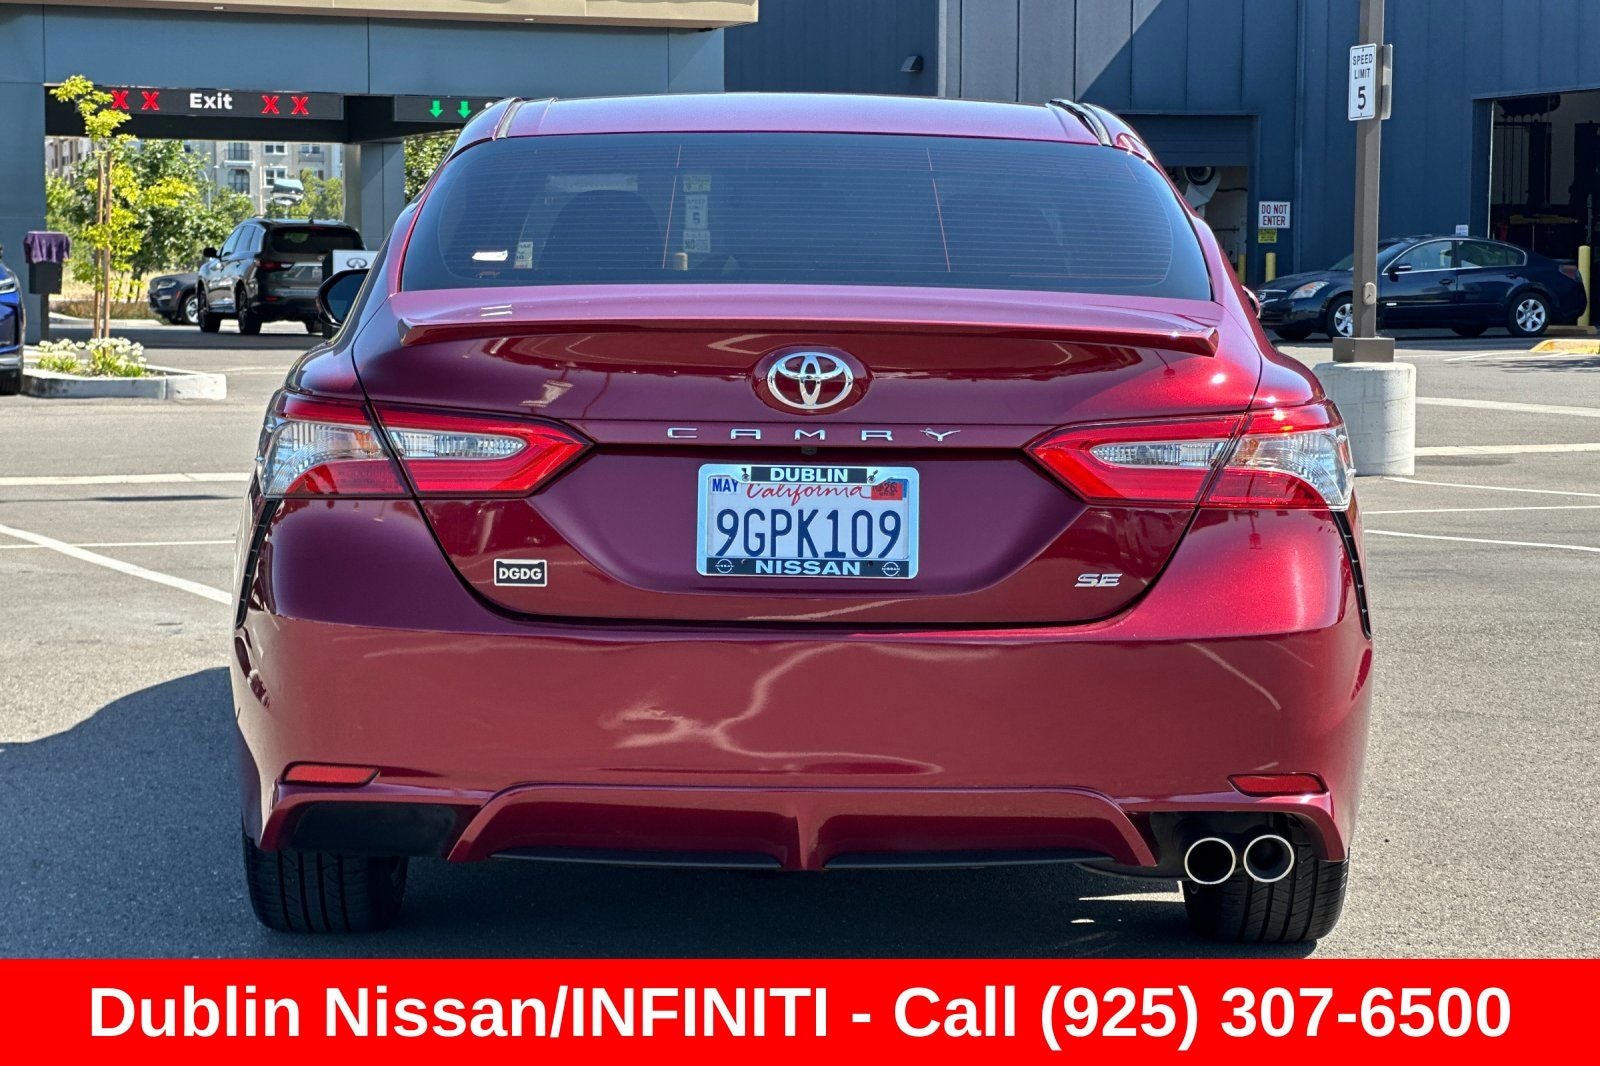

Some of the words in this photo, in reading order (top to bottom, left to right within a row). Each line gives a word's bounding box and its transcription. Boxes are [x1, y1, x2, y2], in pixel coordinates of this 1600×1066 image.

[1352, 54, 1373, 65] SPEED
[1354, 68, 1371, 79] LIMIT
[189, 92, 233, 110] Exit
[1357, 86, 1367, 110] 5
[1261, 204, 1271, 214] DO
[1273, 204, 1288, 214] NOT
[1262, 215, 1286, 226] ENTER
[667, 427, 961, 442] CAMRY
[770, 468, 849, 483] DUBLIN
[711, 478, 740, 493] MAY
[746, 483, 871, 506] California
[715, 508, 901, 559] 9GPK109
[498, 567, 542, 580] DGDG
[755, 560, 861, 576] NISSAN
[1074, 573, 1123, 587] SE
